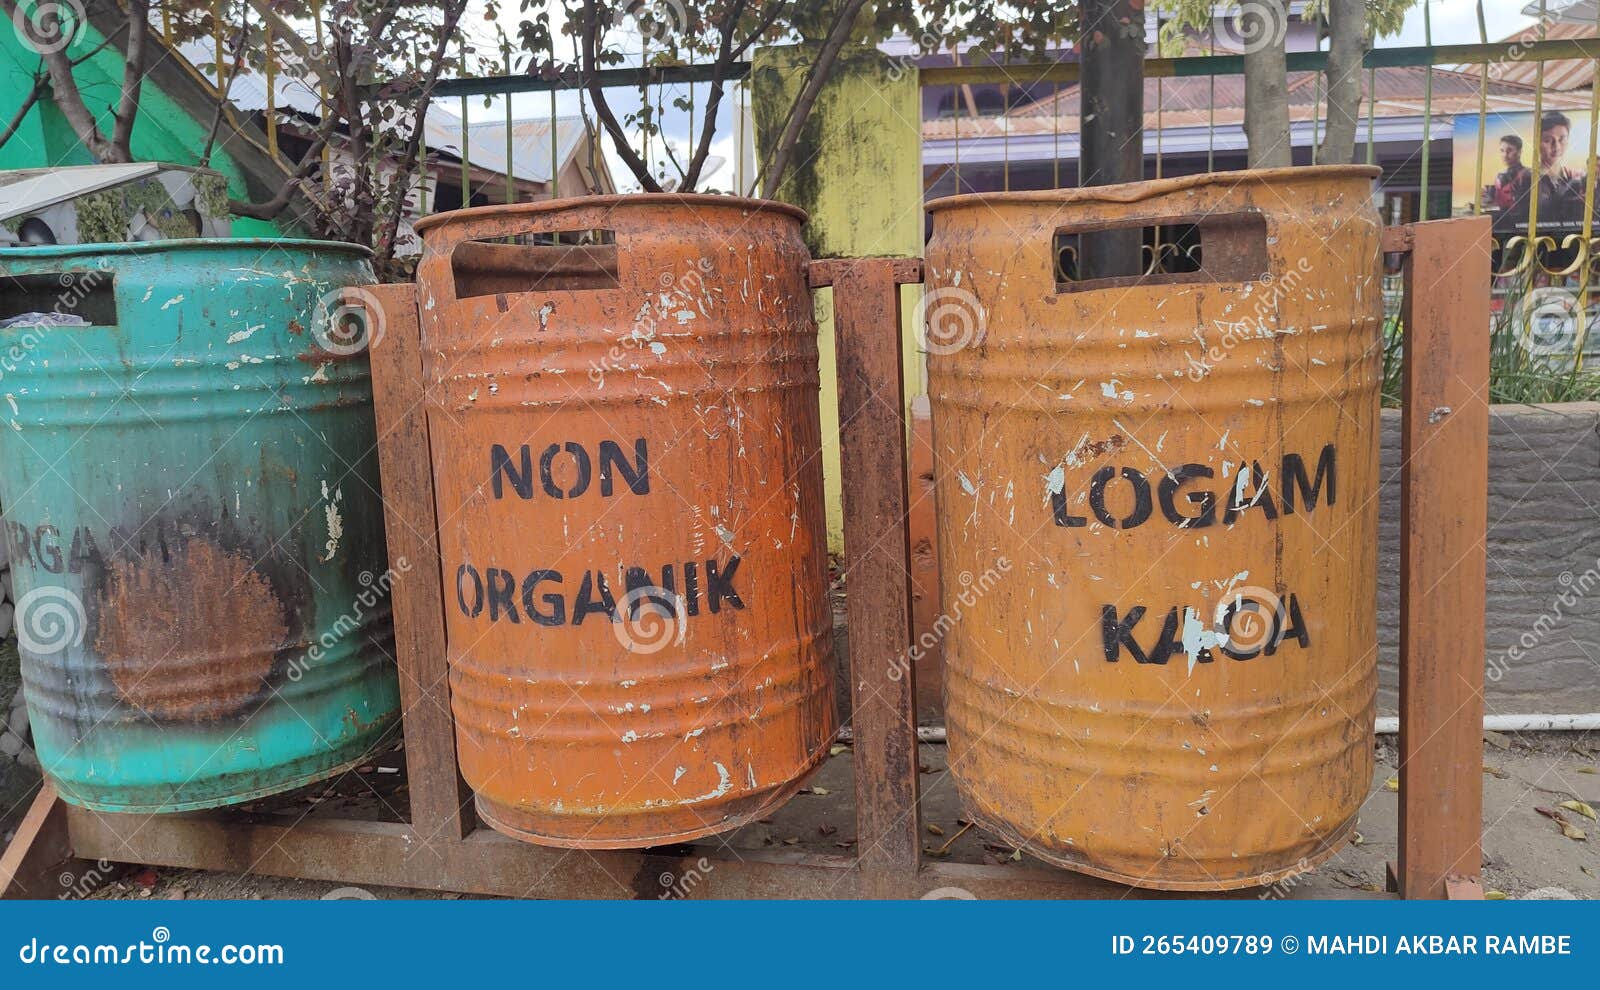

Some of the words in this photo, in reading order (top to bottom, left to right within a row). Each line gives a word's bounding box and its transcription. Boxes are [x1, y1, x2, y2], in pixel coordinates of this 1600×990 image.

[491, 437, 650, 500] NON
[1050, 443, 1336, 530] LOGAM
[456, 554, 746, 626] ORGANIK
[1102, 593, 1310, 664] KACA
